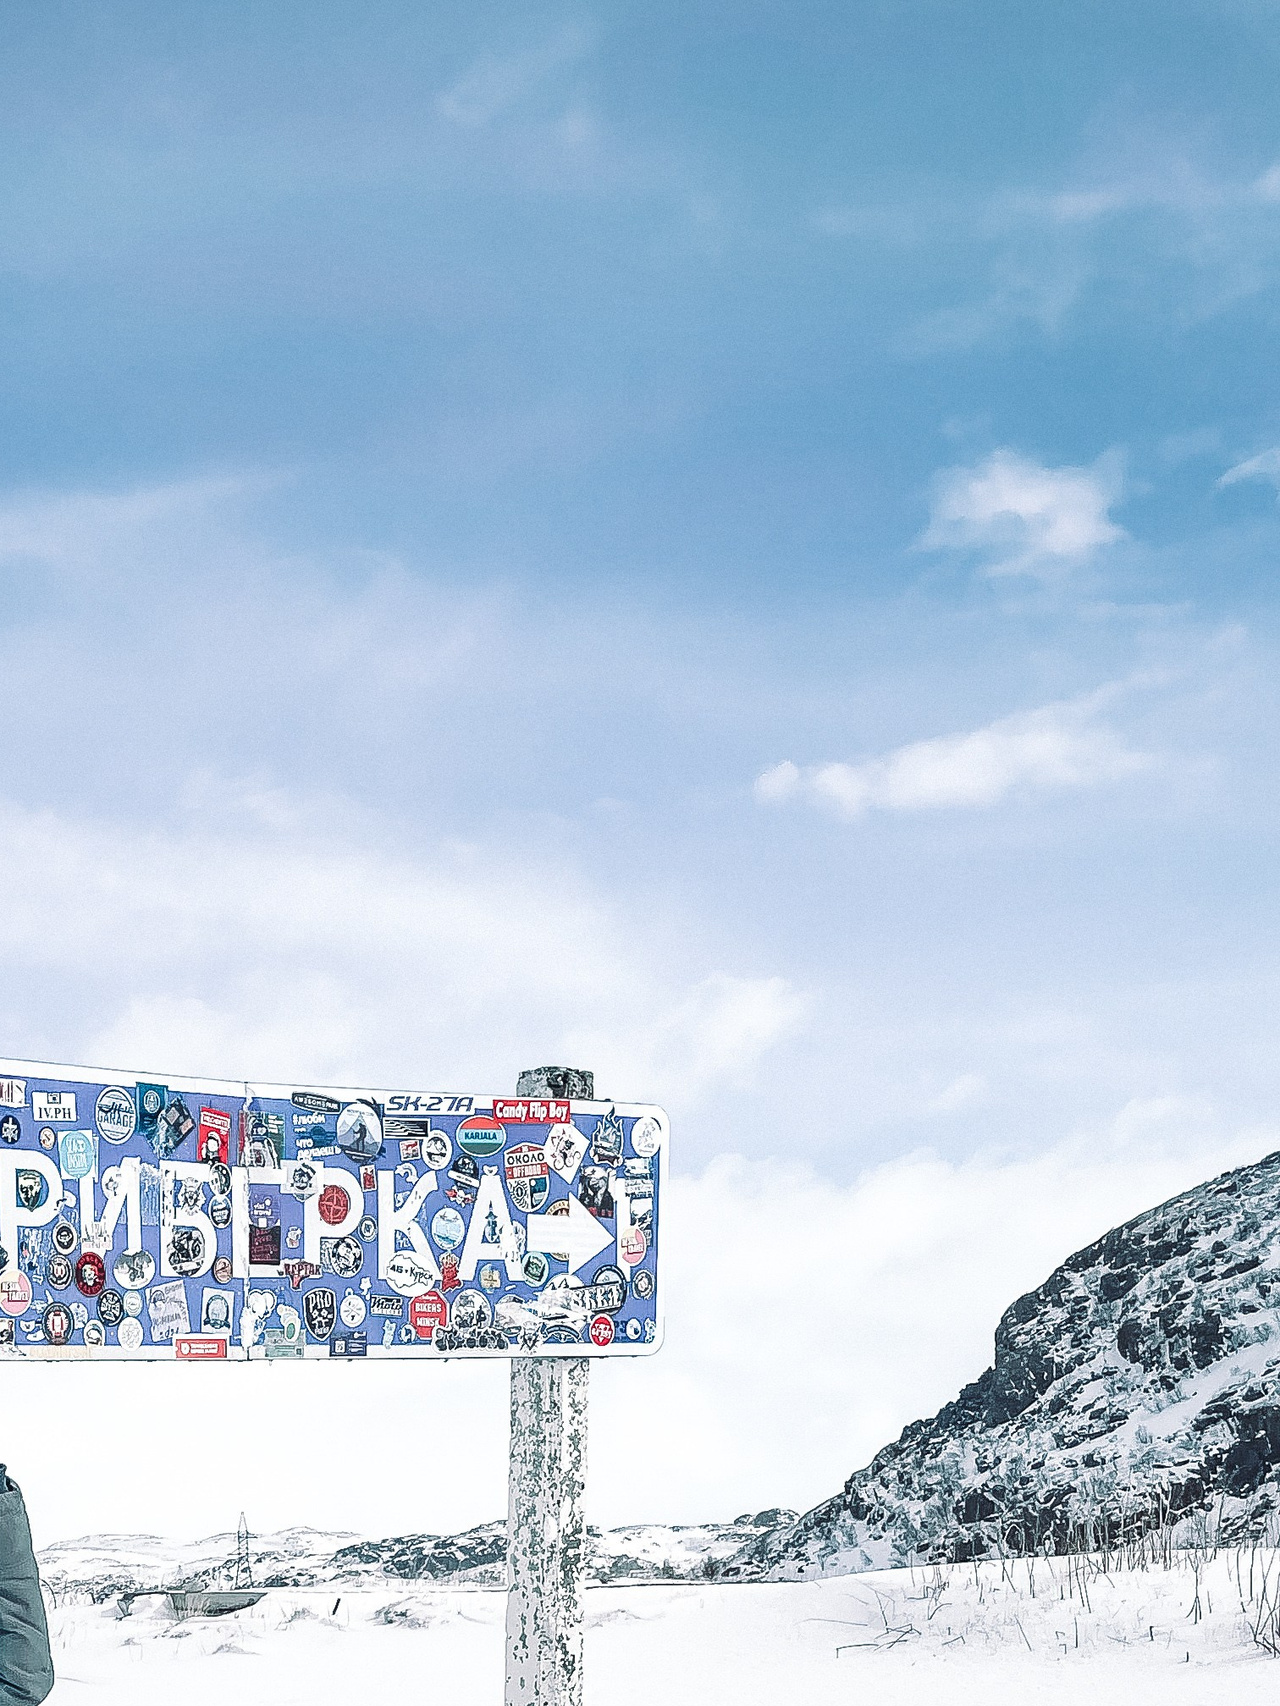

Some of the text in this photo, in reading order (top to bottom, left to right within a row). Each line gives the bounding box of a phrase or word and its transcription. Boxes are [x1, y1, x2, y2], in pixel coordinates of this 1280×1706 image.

[387, 1096, 474, 1112] SK-27A
[496, 1101, 568, 1122] Candy Flip Boy
[97, 1112, 134, 1129] GARAGE
[464, 1131, 498, 1141] KARJALA
[512, 1165, 542, 1179] OFFROAD
[284, 1263, 322, 1276] REPTAR
[410, 1266, 433, 1284] Курск
[414, 1303, 442, 1313] BIKERS
[416, 1317, 440, 1327] MINSK
